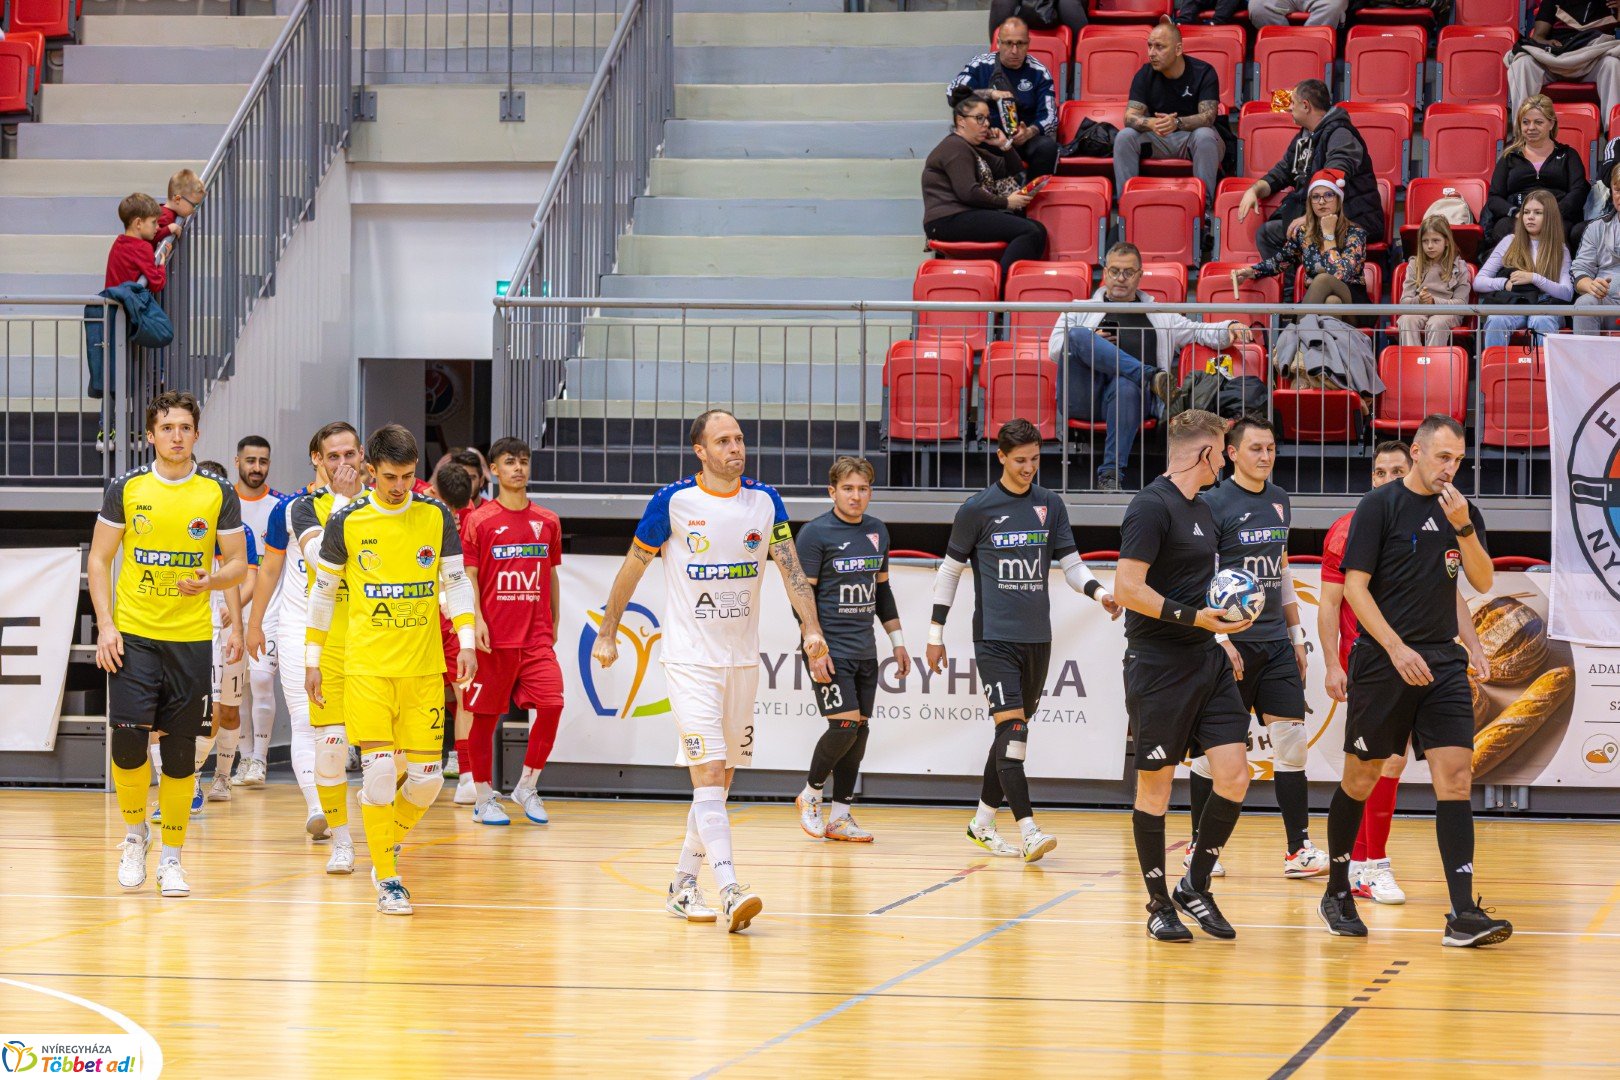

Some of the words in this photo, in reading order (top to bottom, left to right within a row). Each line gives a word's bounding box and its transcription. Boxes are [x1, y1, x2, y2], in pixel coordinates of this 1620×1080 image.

[773, 525, 788, 541] C
[998, 547, 1043, 580] mvl
[497, 561, 541, 591] mvl
[137, 585, 184, 597] STUD
[997, 583, 1018, 591] mezei
[1020, 583, 1028, 591] vill
[496, 593, 516, 601] mezei
[695, 589, 752, 608] A'90
[371, 601, 430, 617] A'90
[694, 606, 751, 619] STUDIO
[371, 617, 428, 628] STUDIO
[821, 683, 843, 710] 23
[984, 680, 1006, 708] 21
[201, 695, 213, 718] 1
[796, 702, 818, 717] JO
[684, 737, 700, 747] 99.4
[740, 725, 754, 748] 3
[161, 823, 183, 832] JAKO
[713, 860, 732, 869] JAKO
